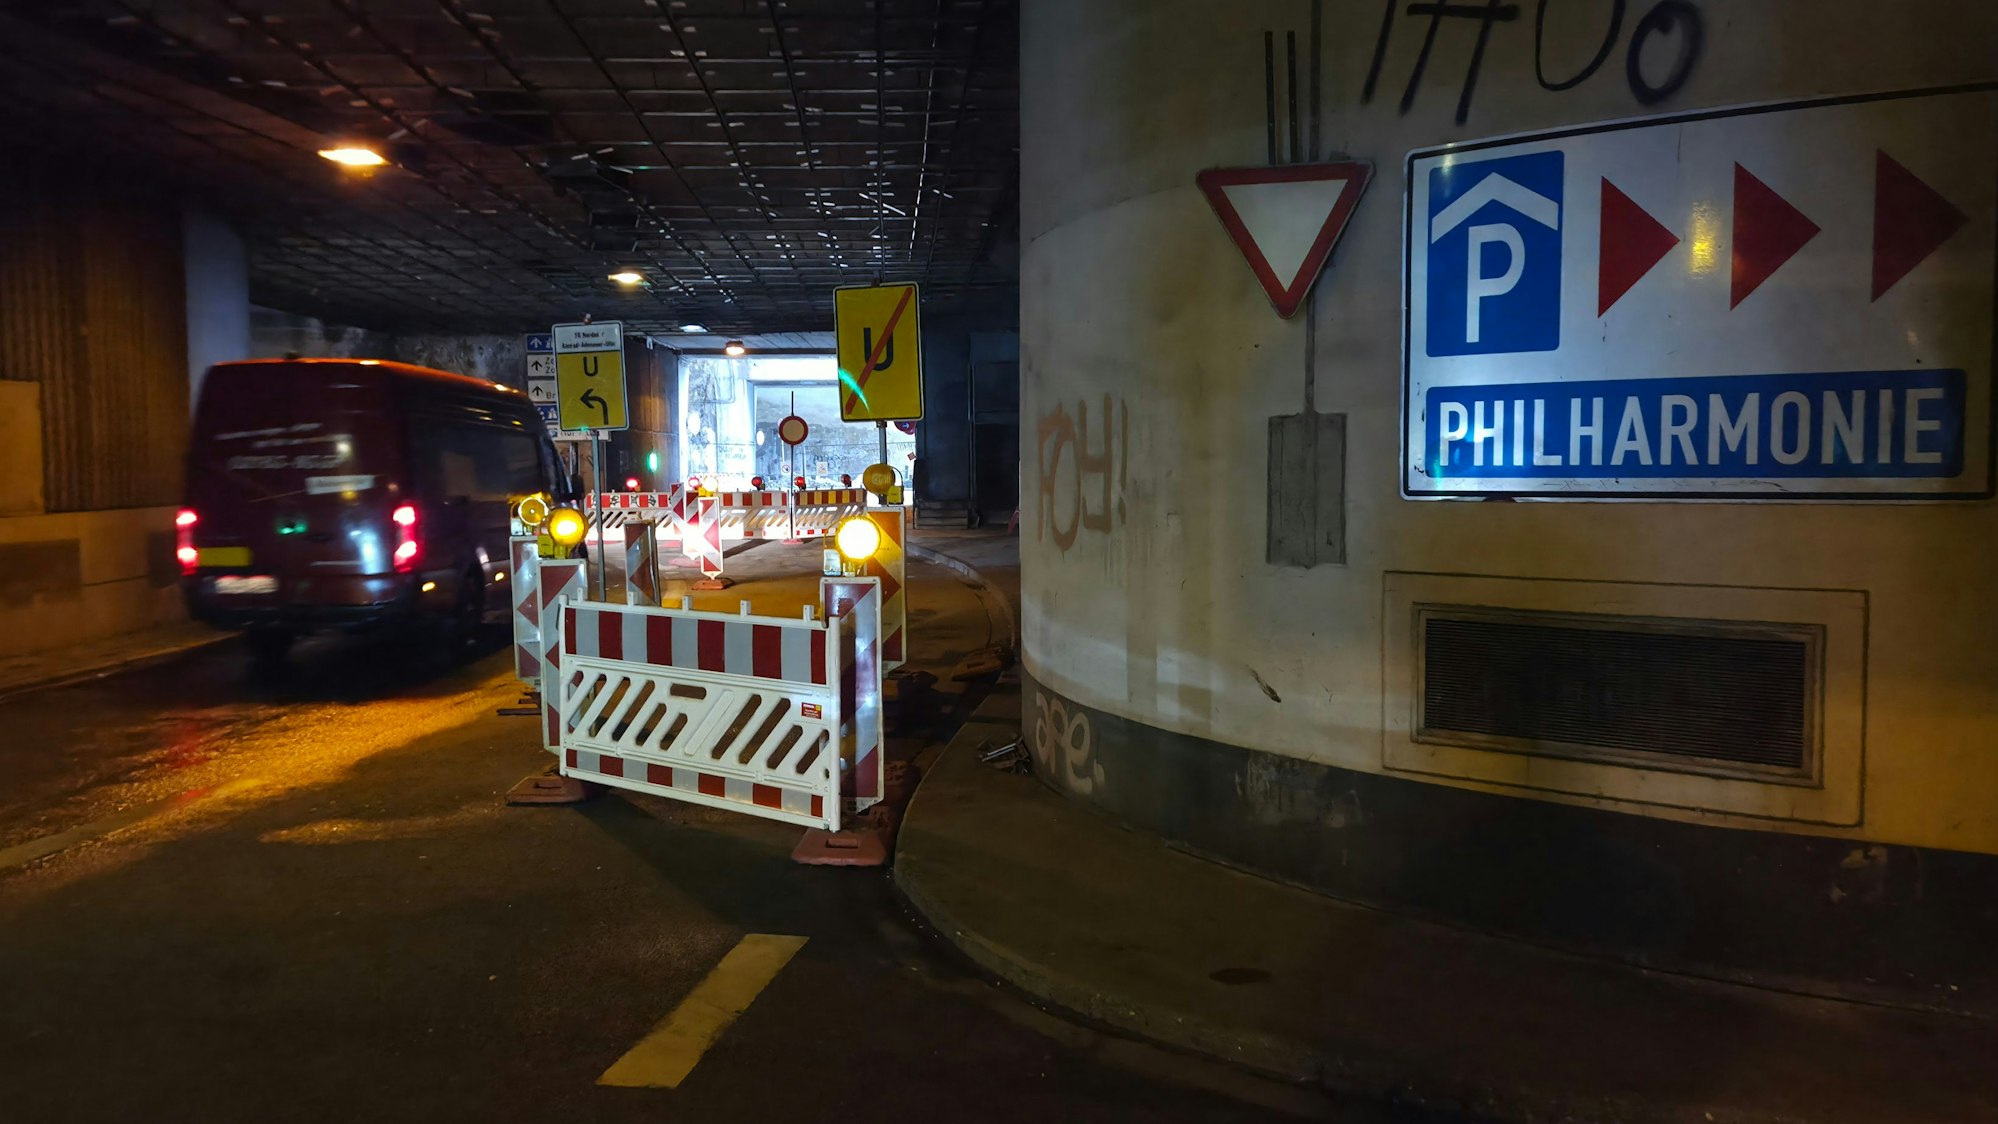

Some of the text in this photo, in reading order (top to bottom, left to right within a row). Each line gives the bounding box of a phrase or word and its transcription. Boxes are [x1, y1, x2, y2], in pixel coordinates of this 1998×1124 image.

[1466, 222, 1526, 343] P
[583, 356, 598, 377] U
[863, 327, 894, 371] U
[1438, 387, 1946, 468] PHILHARMONIE
